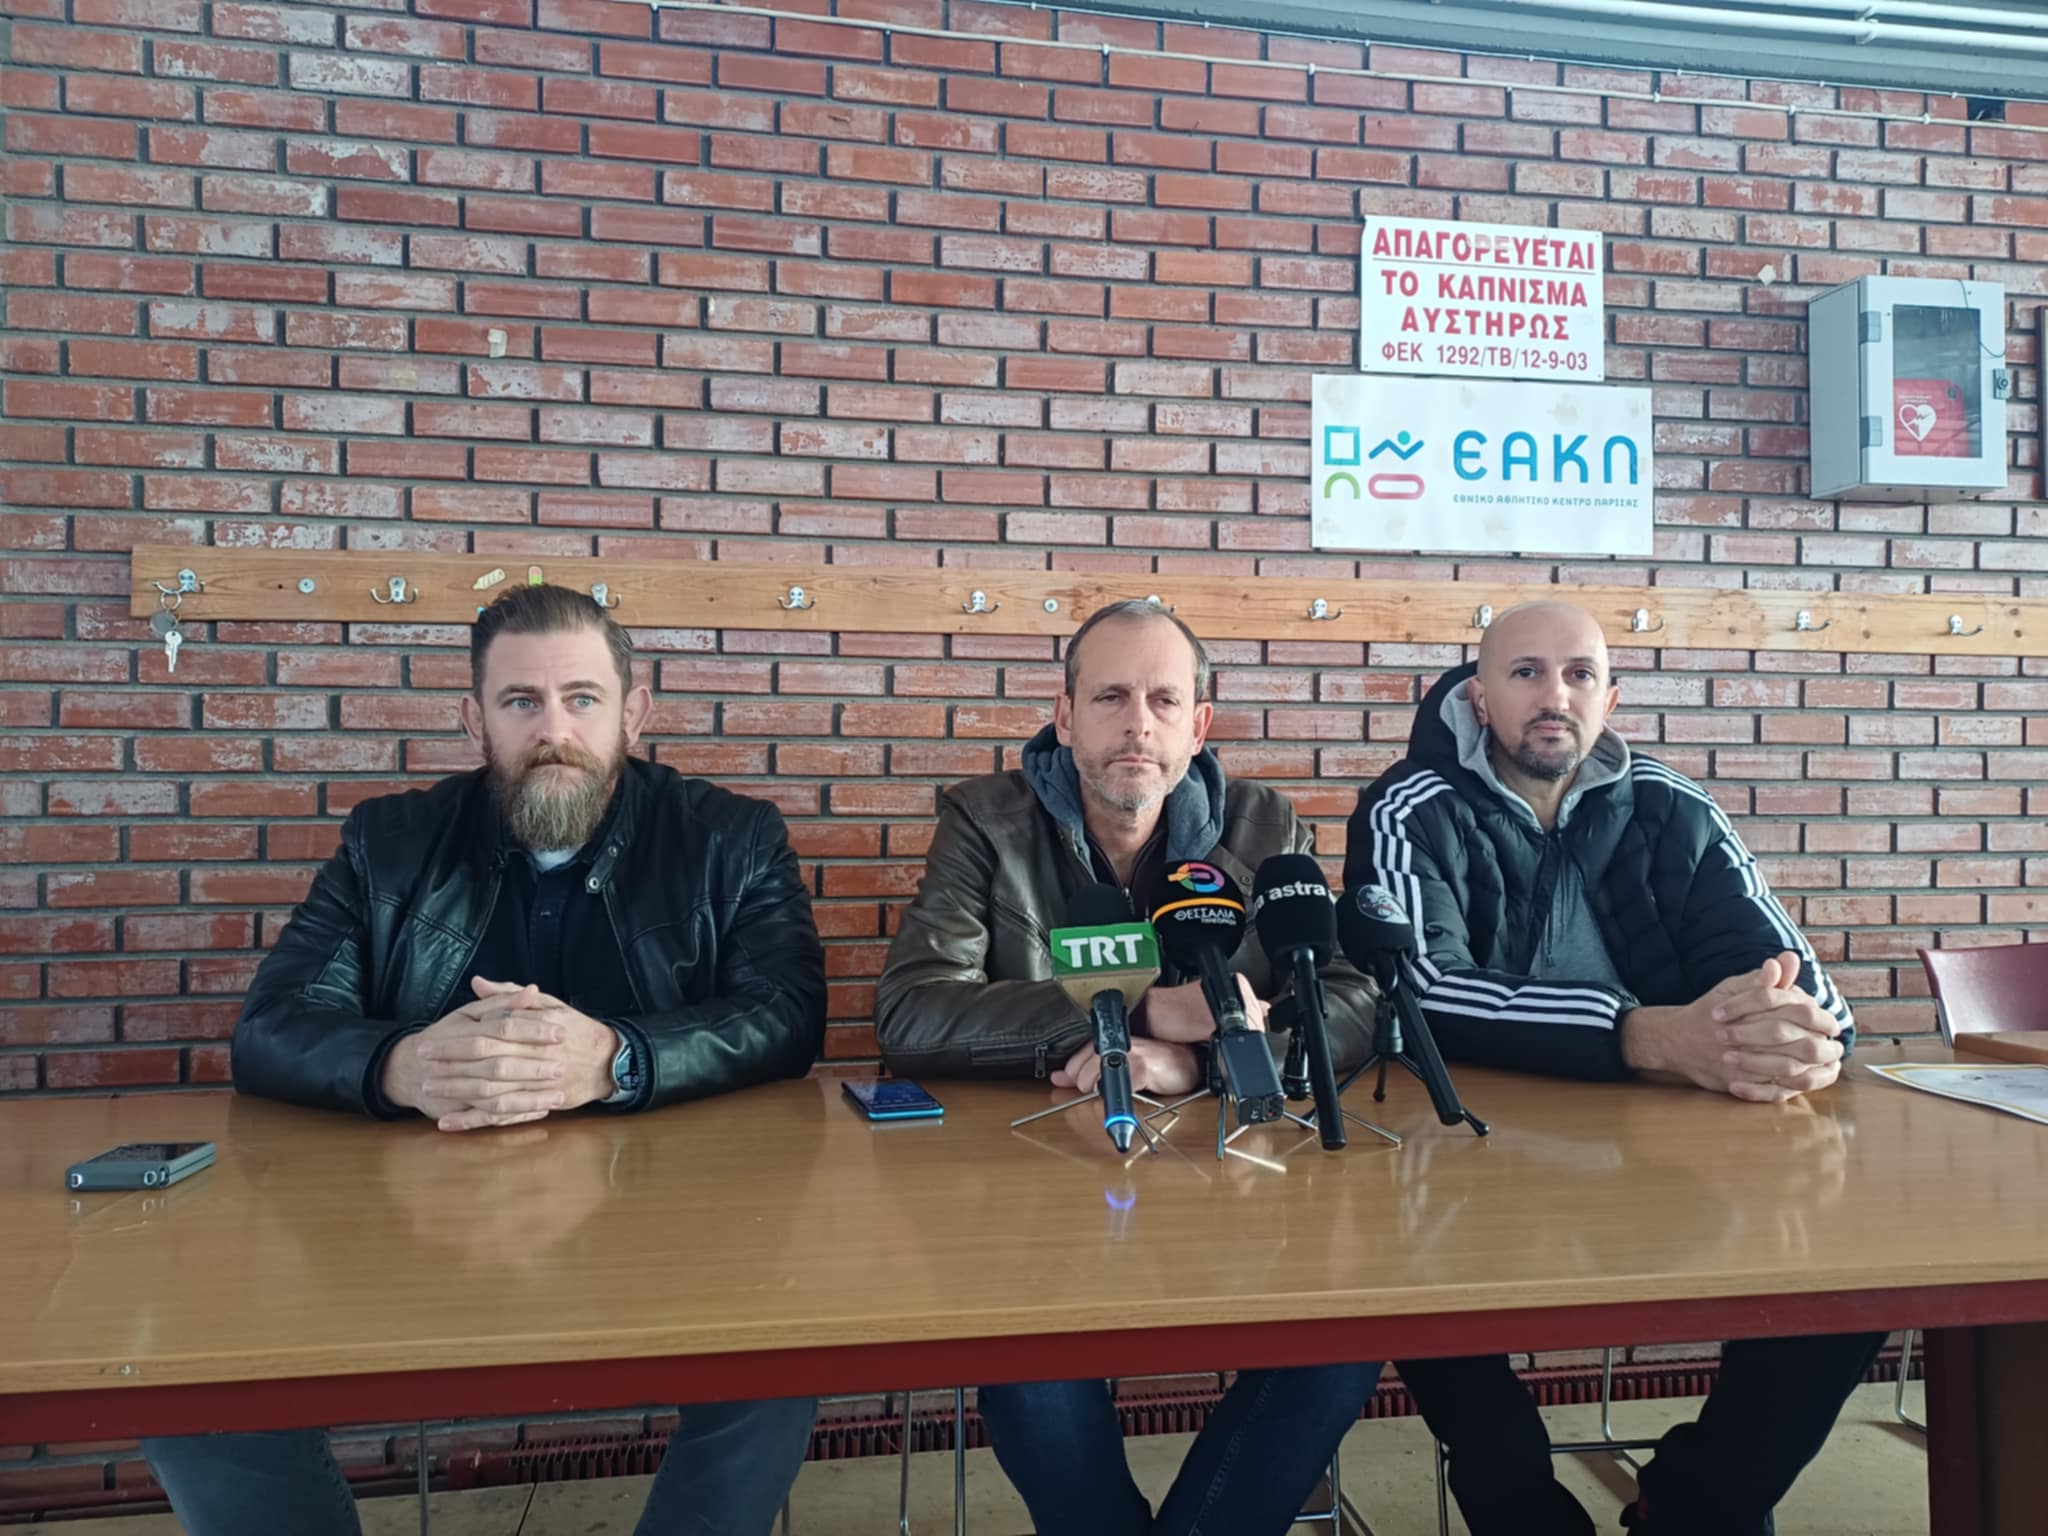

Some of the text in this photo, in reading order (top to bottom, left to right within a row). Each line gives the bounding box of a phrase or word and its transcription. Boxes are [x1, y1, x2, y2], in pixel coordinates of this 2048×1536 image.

[1373, 227, 1595, 270] ΑΠΑΓΟΡΕΥΕΤΑΙ
[1381, 269, 1588, 308] ΤΟ ΚΑΠΝΙΣΜΑ
[1401, 306, 1569, 341] ΑΥΣΤΗΡΩΣ
[1381, 341, 1424, 363] ΦΕΚ
[1453, 493, 1494, 504] ΕΘΝΙΚΟ
[1552, 497, 1591, 507] ΚΕΝΤΡΟ
[1269, 881, 1326, 901] astra
[1174, 907, 1236, 921] ΘΕΣΣΑΛΙΑ
[1061, 933, 1144, 968] TRT
